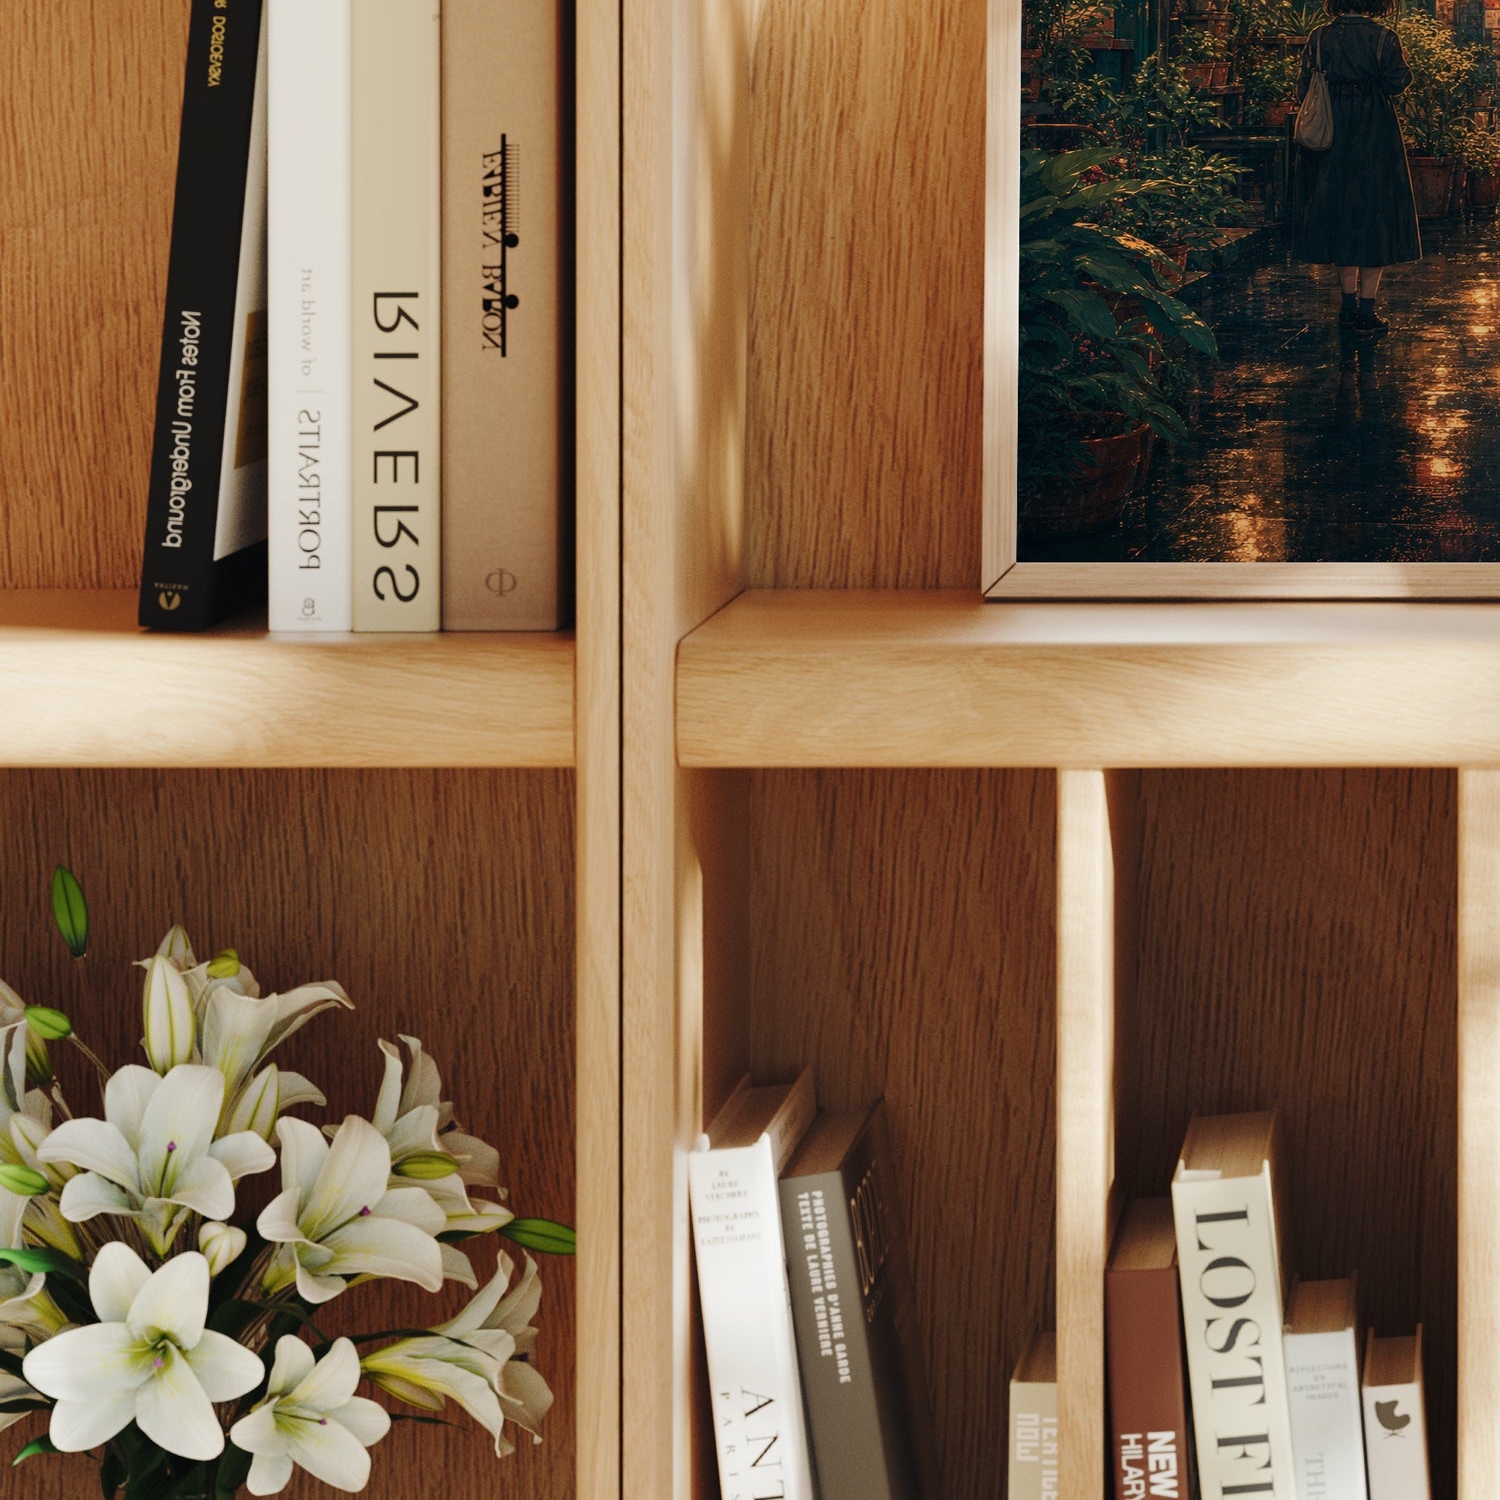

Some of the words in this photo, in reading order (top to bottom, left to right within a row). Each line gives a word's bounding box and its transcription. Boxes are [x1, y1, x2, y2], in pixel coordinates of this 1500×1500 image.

[797, 1192, 813, 1230] TEXTE
[804, 1233, 816, 1251] DE
[810, 1190, 837, 1289] PHOTOGRAPHIES
[806, 1255, 823, 1294] LAURE
[826, 1293, 845, 1340] D'ANNE
[1194, 1204, 1267, 1408] LOST
[834, 1343, 852, 1384] GARDE
[1146, 1431, 1179, 1499] NEW
